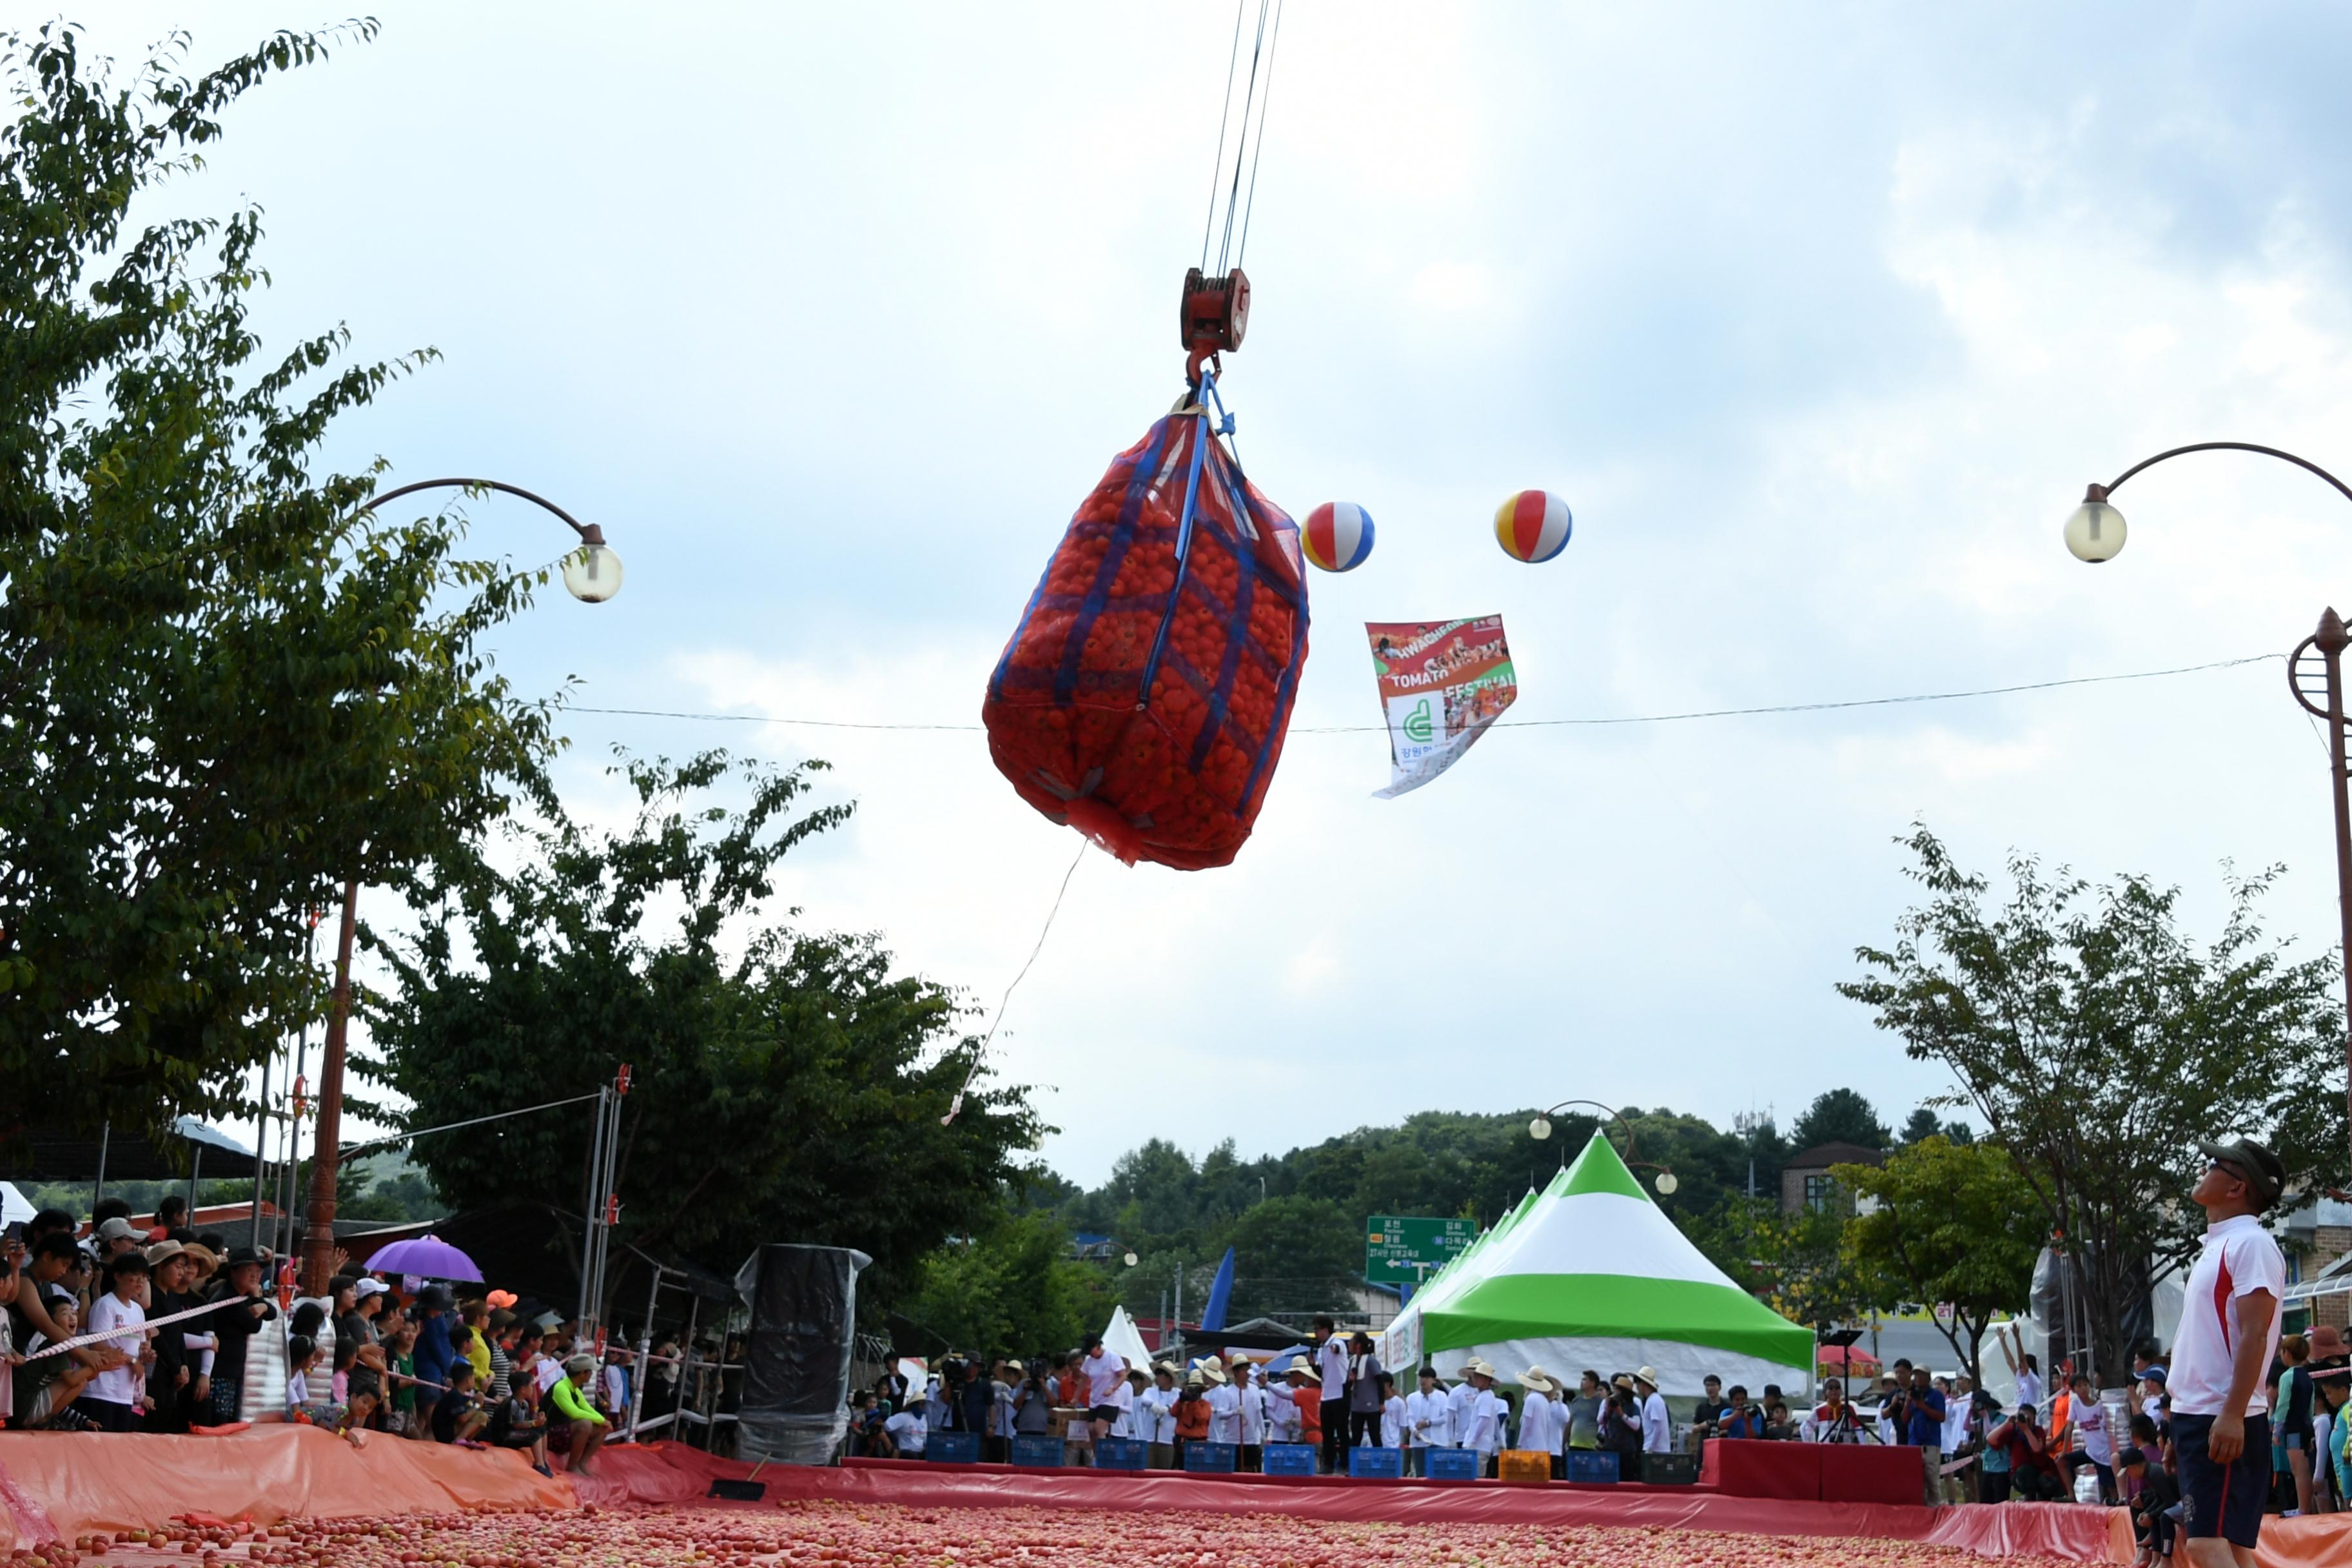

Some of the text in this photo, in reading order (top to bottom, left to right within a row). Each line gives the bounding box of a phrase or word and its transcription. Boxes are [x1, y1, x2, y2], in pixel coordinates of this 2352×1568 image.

[1396, 620, 1465, 660] HWACHEON
[1391, 669, 1449, 688] TOMATO
[1384, 1220, 1400, 1228] 포천
